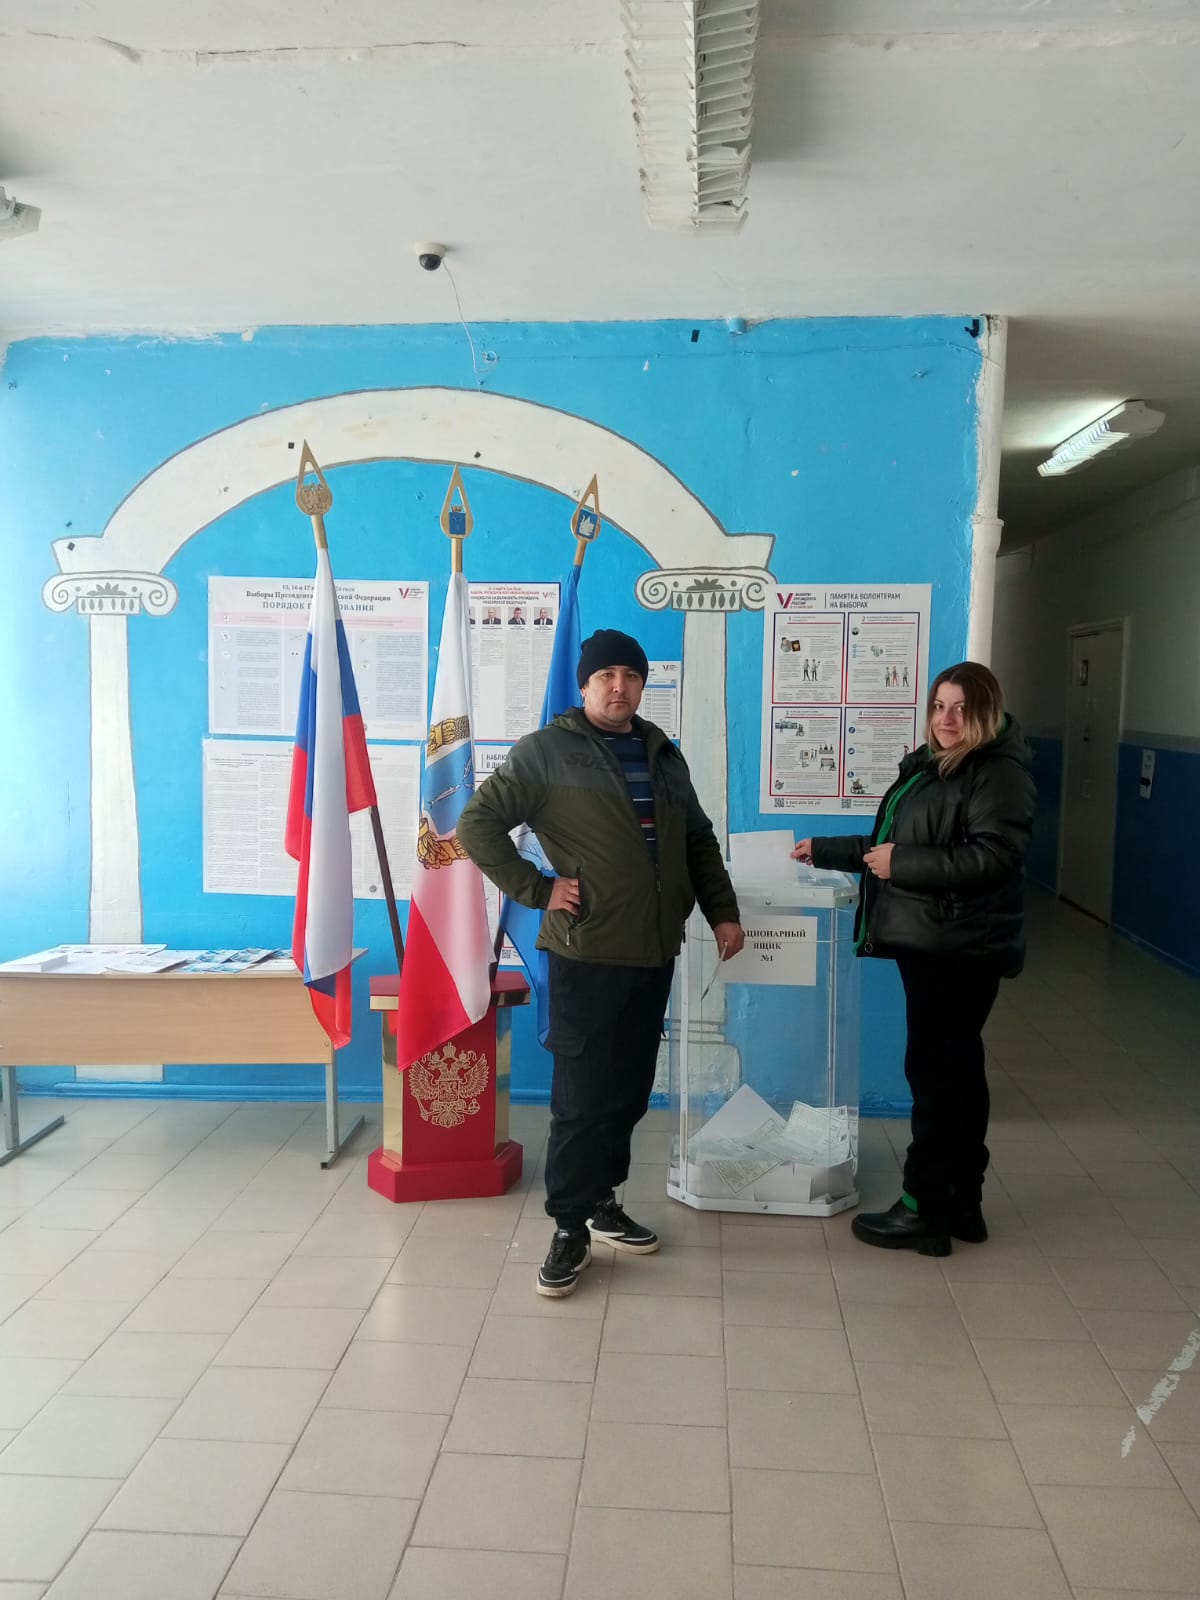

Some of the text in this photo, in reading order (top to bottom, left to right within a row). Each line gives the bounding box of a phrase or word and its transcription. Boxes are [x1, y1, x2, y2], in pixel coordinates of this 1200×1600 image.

[246, 590, 314, 600] Выборы Президента
[354, 593, 391, 603] Федерации
[829, 592, 901, 601] ПАМЯТКА ВОЛОНТЕРАМ
[262, 601, 305, 610] ПОРЯДОК
[829, 601, 868, 609] НА ВЫБОРАХ
[753, 942, 782, 951] ЯЩИК
[760, 954, 773, 962] №1
